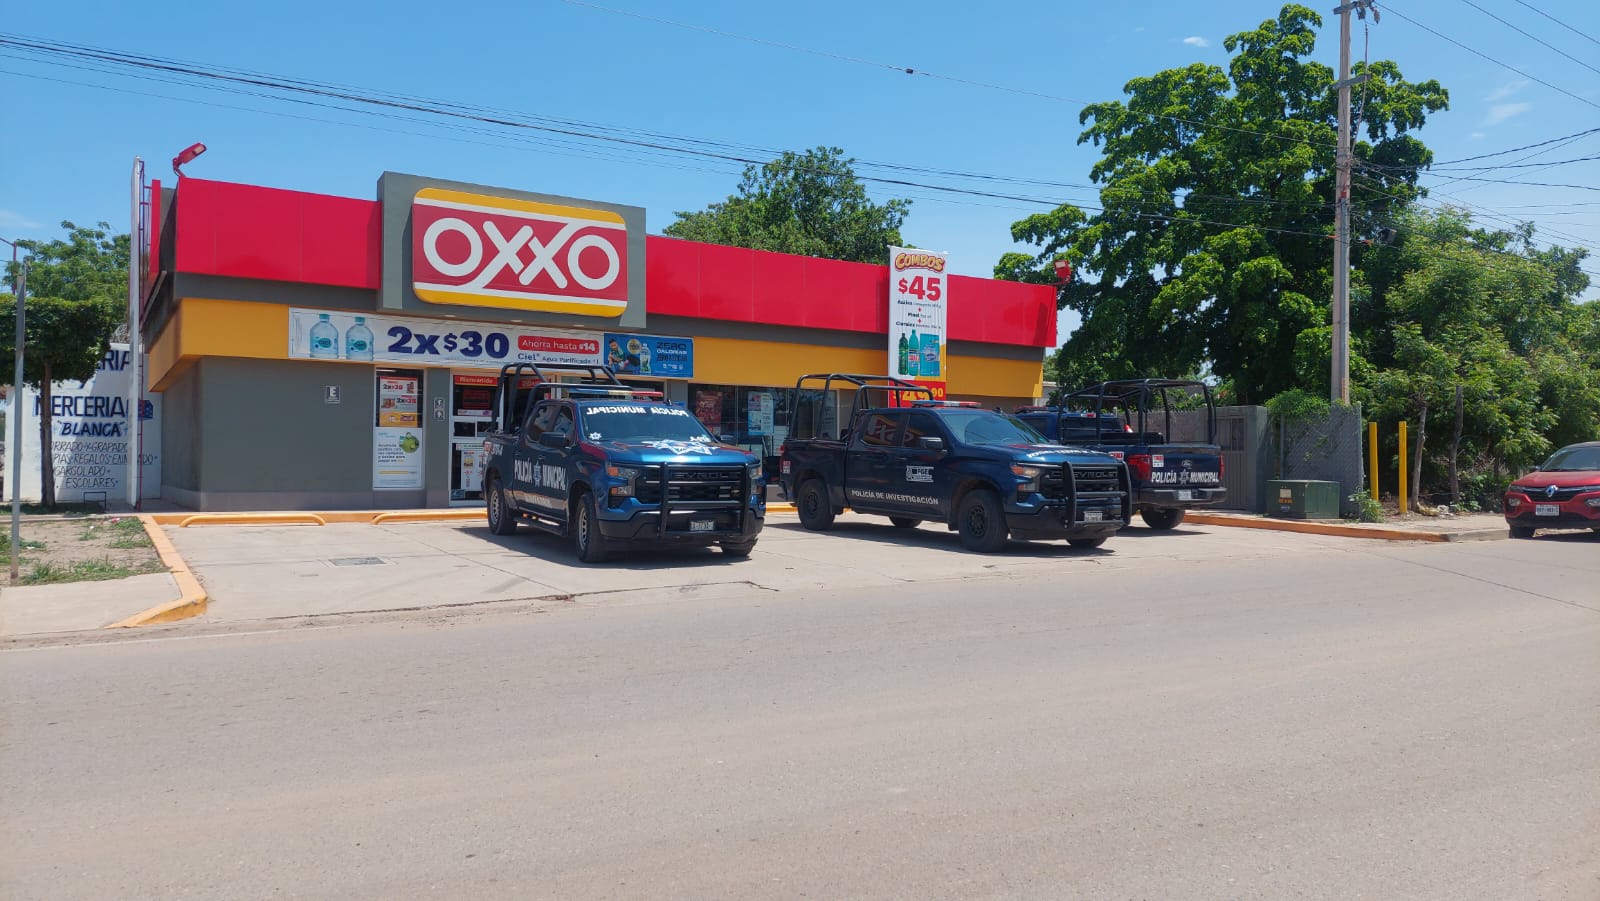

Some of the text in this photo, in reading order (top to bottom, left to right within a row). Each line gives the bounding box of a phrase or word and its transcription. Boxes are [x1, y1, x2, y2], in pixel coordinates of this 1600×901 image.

[423, 217, 620, 291] OXXO
[895, 252, 945, 272] COMBOS
[897, 275, 942, 302] $45
[522, 339, 551, 349] Ahorra
[553, 341, 578, 351] hasta
[65, 477, 116, 488] ESCOLARES
[1151, 470, 1219, 484] POLICÍA MUNICIPAL
[851, 489, 939, 505] POLICÍA DE INVESTIGACIÓN
